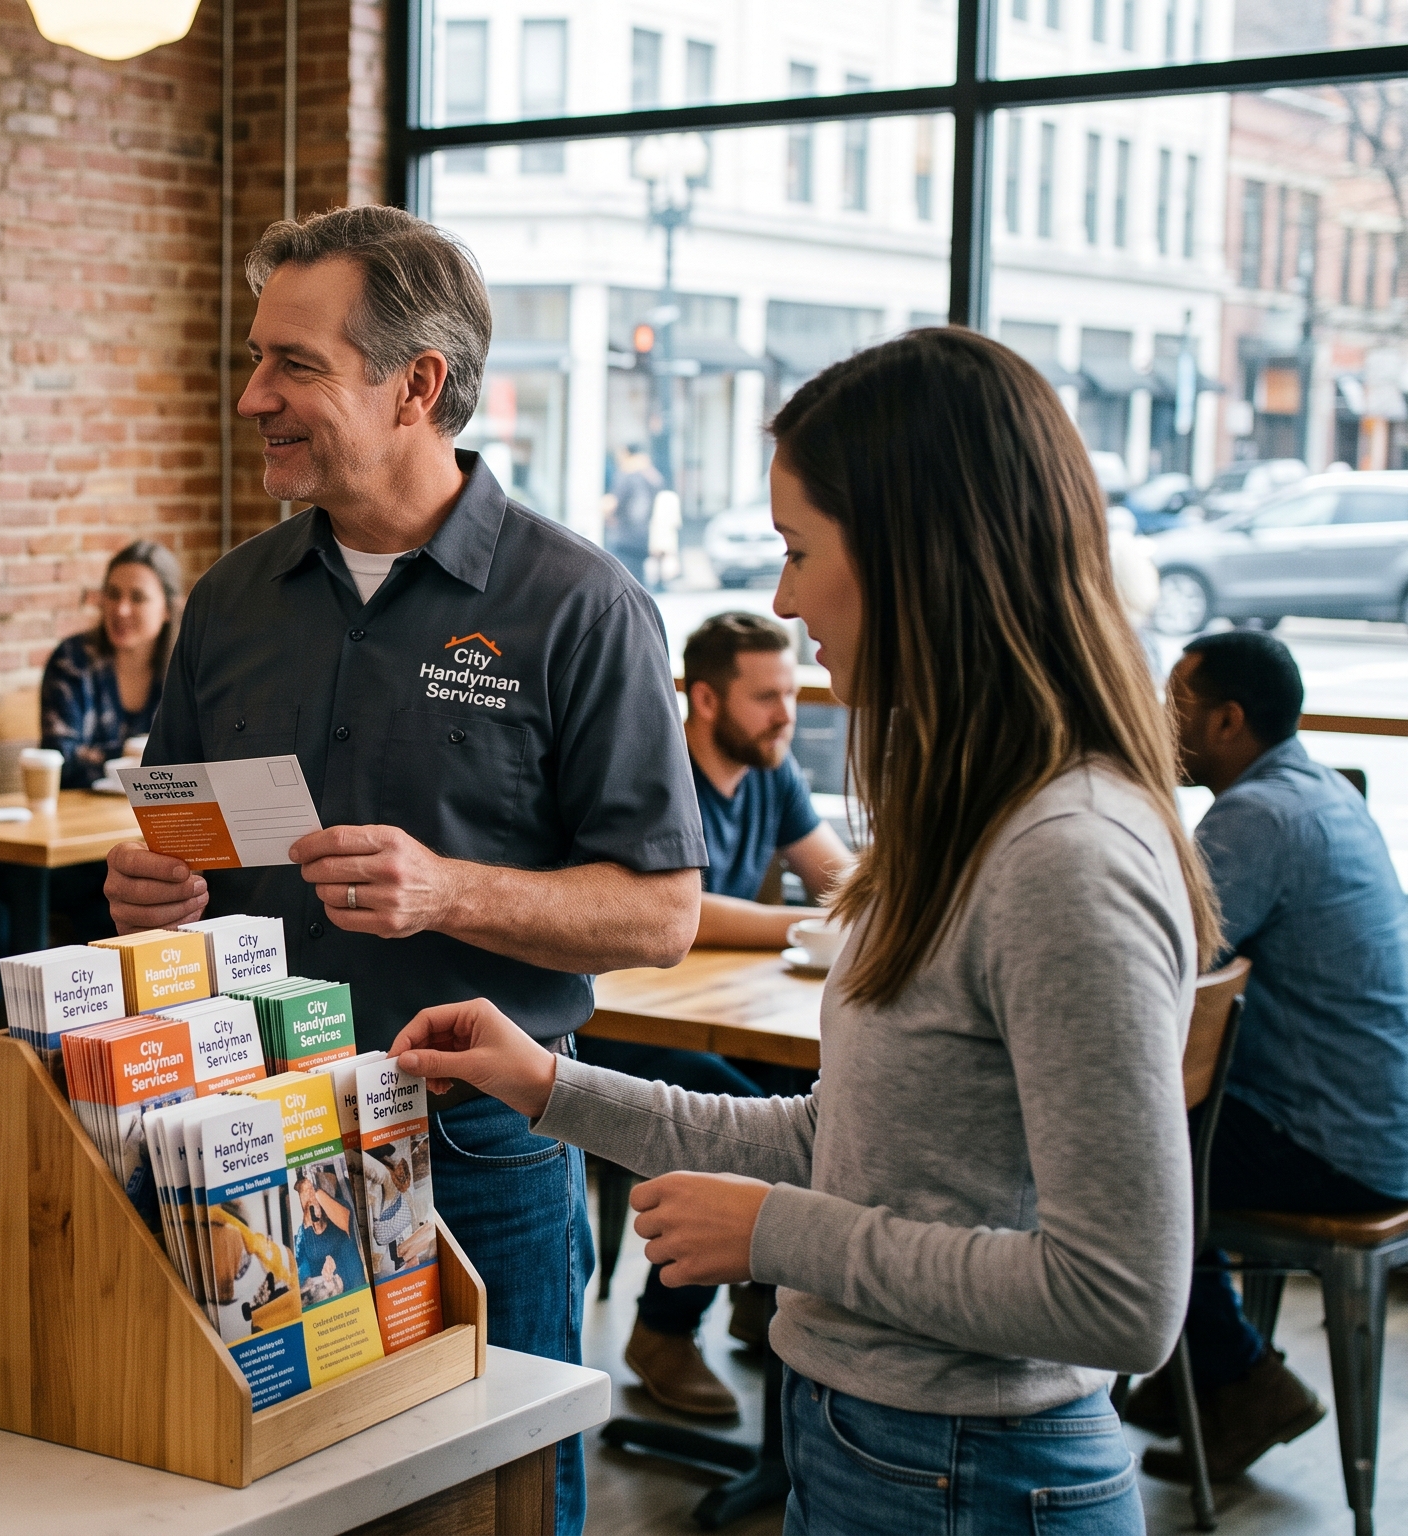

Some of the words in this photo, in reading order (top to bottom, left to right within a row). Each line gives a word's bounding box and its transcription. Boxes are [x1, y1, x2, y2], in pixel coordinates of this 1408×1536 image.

[454, 648, 492, 671] City
[419, 662, 520, 692] Handyman
[425, 682, 506, 709] Services
[149, 771, 173, 781] City
[238, 934, 259, 948] City
[161, 948, 182, 964] City
[224, 947, 277, 966] Handyman
[71, 969, 94, 985] City
[144, 962, 201, 983] Handyman
[231, 963, 272, 980] Services
[53, 983, 114, 1004] Handyman
[62, 1000, 108, 1019] Services
[307, 1000, 328, 1016] City
[213, 1020, 234, 1035] City
[293, 1013, 347, 1035] Handyman
[139, 1040, 164, 1057] City
[198, 1032, 253, 1055] Handyman
[300, 1029, 342, 1048] Services
[123, 1052, 185, 1078] Handyman
[206, 1049, 248, 1069] Services
[131, 1070, 179, 1093] Services
[380, 1071, 400, 1086] City
[285, 1093, 307, 1109] City
[366, 1083, 419, 1106] Handyman
[282, 1105, 328, 1128] ndyman
[373, 1100, 414, 1120] Services
[230, 1121, 254, 1137] City
[214, 1133, 274, 1159] Handyman
[222, 1151, 270, 1173] Services
